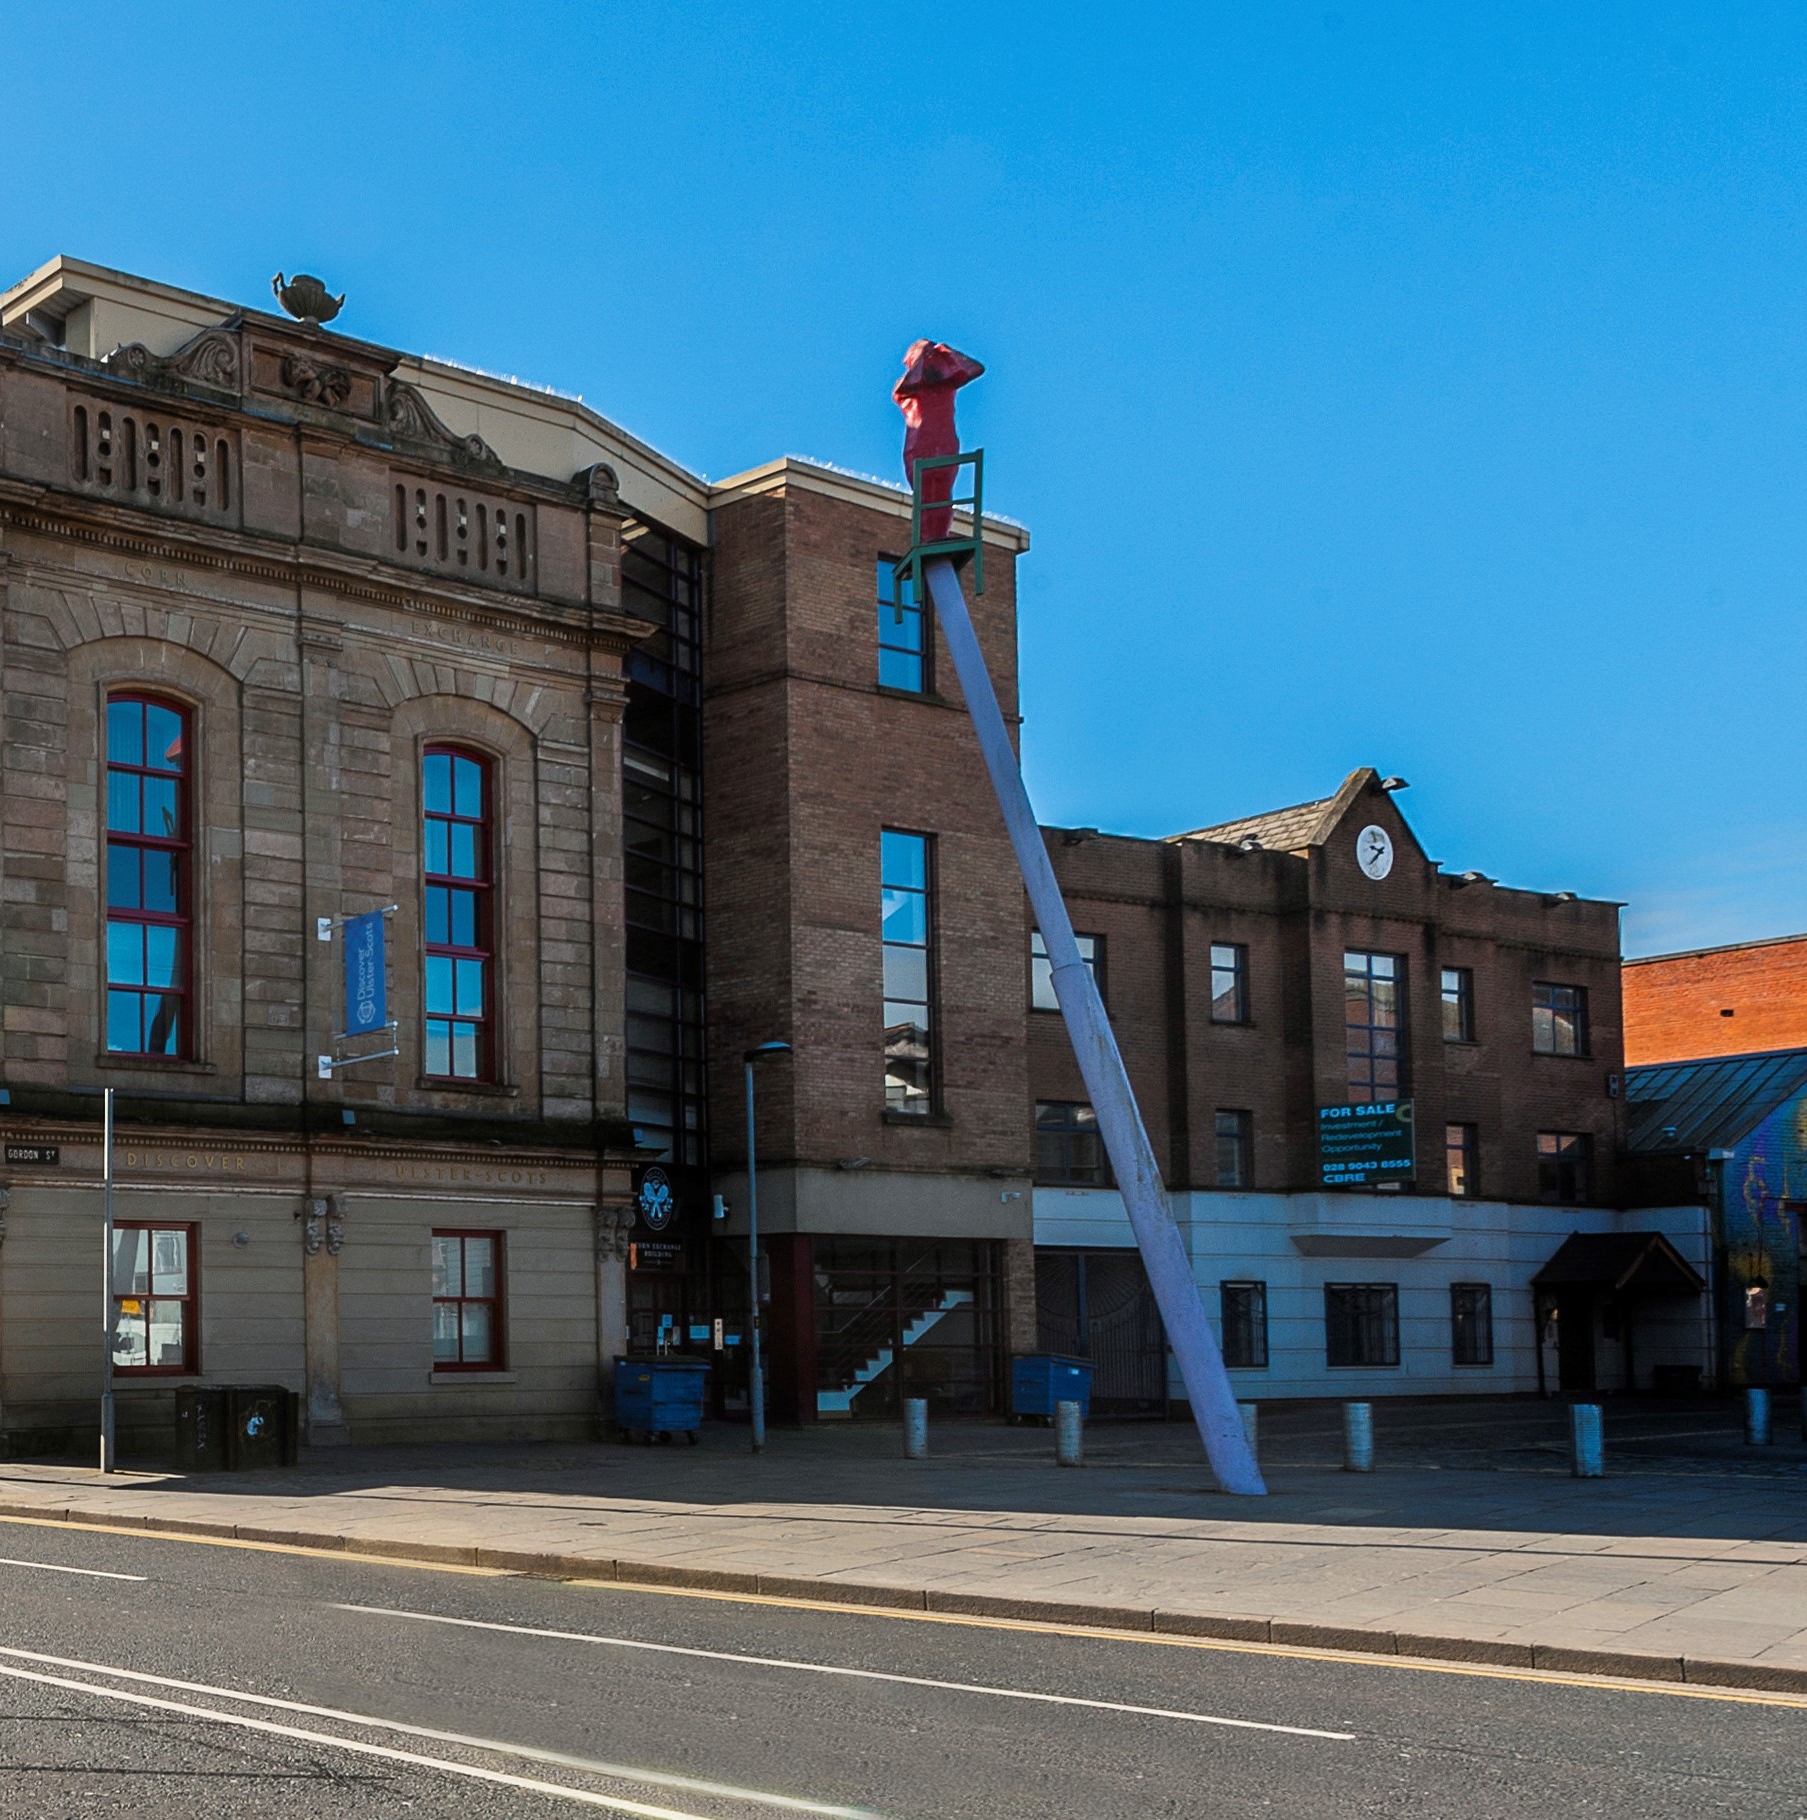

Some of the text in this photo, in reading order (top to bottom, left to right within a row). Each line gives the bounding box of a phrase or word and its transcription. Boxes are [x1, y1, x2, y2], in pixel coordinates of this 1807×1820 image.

[124, 562, 519, 654] CORN EXCHANGE
[365, 921, 374, 998] Ulster-Scots
[357, 947, 365, 1001] Discover
[1320, 1104, 1395, 1118] FOR SALE
[1321, 1120, 1377, 1130] Investment
[1321, 1130, 1402, 1141] Redevelopment
[1322, 1143, 1382, 1153] Opportunity
[8, 1149, 38, 1160] GORDON
[127, 1152, 547, 1185] DISCOVER ULSTER-SCOTS
[1323, 1163, 1345, 1172] 028
[1348, 1161, 1377, 1170] 9043
[1323, 1173, 1365, 1183] CBRE
